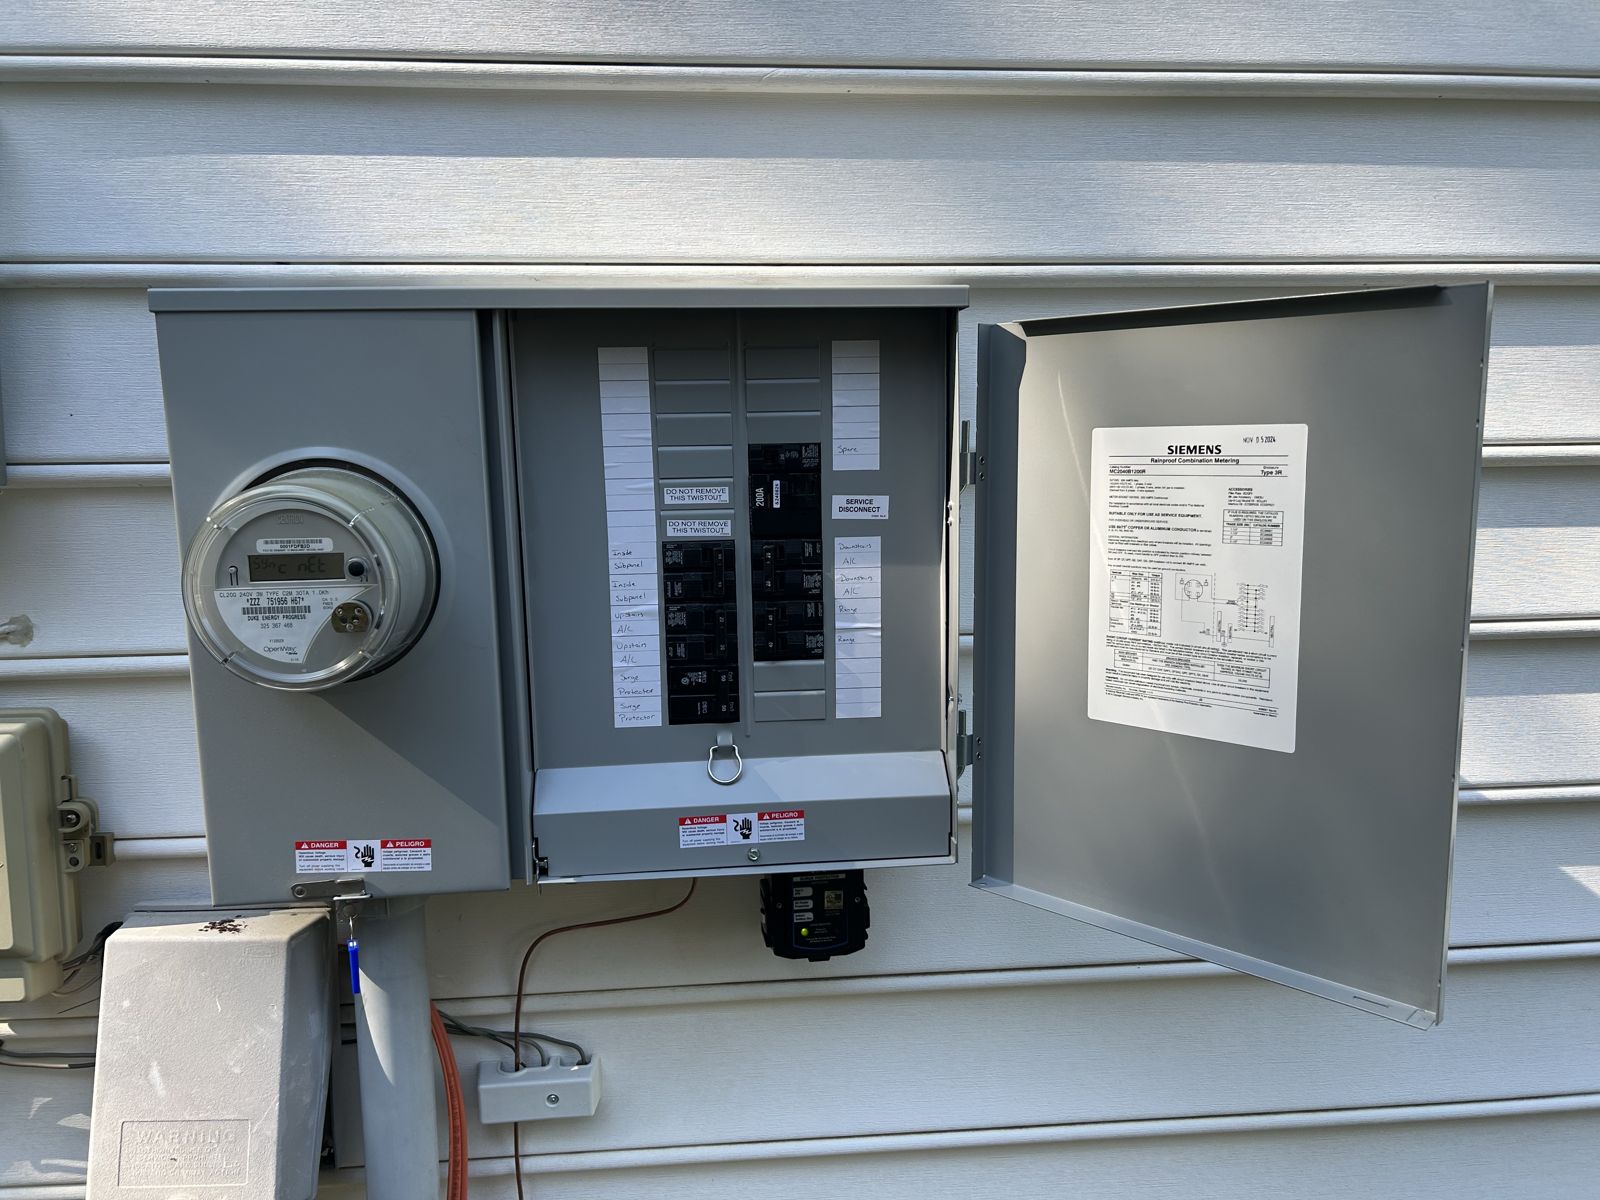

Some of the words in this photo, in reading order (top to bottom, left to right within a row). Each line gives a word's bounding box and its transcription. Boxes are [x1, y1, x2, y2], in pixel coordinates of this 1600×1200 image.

[837, 445, 858, 454] Spare
[1167, 445, 1222, 454] SIEMENS
[755, 487, 764, 507] 200A
[614, 562, 643, 570] Subpanel
[266, 597, 288, 605] 751956
[615, 593, 646, 603] Subpanel
[839, 605, 858, 614] Range
[616, 625, 633, 634] A/C
[838, 636, 855, 644] Range
[620, 654, 637, 664] A/C
[617, 688, 654, 696] Protector
[137, 1130, 233, 1143] WARNING
